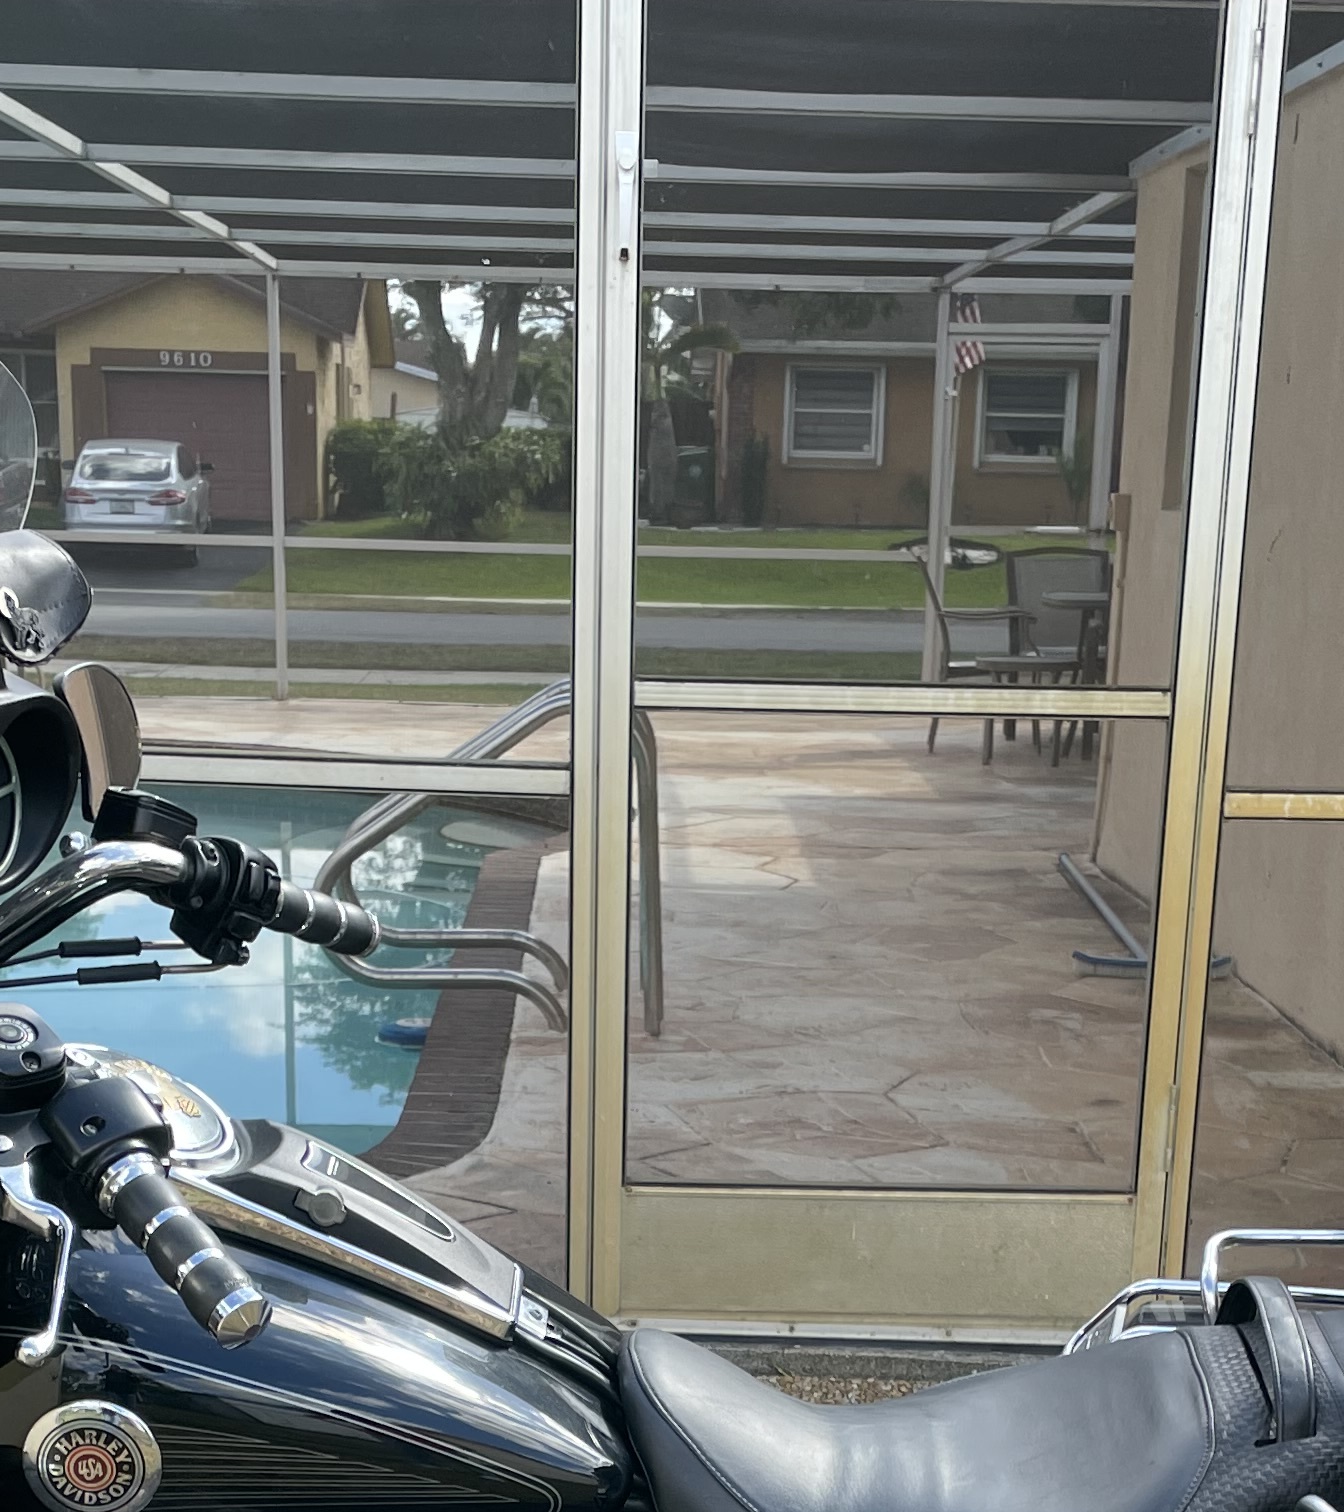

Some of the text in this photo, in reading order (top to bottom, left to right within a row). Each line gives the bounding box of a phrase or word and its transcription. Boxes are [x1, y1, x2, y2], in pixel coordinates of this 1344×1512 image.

[159, 350, 212, 367] 9610
[55, 1429, 132, 1464] HARLEY
[48, 1463, 133, 1505] DAVIDSON
[78, 1458, 104, 1481] USA
